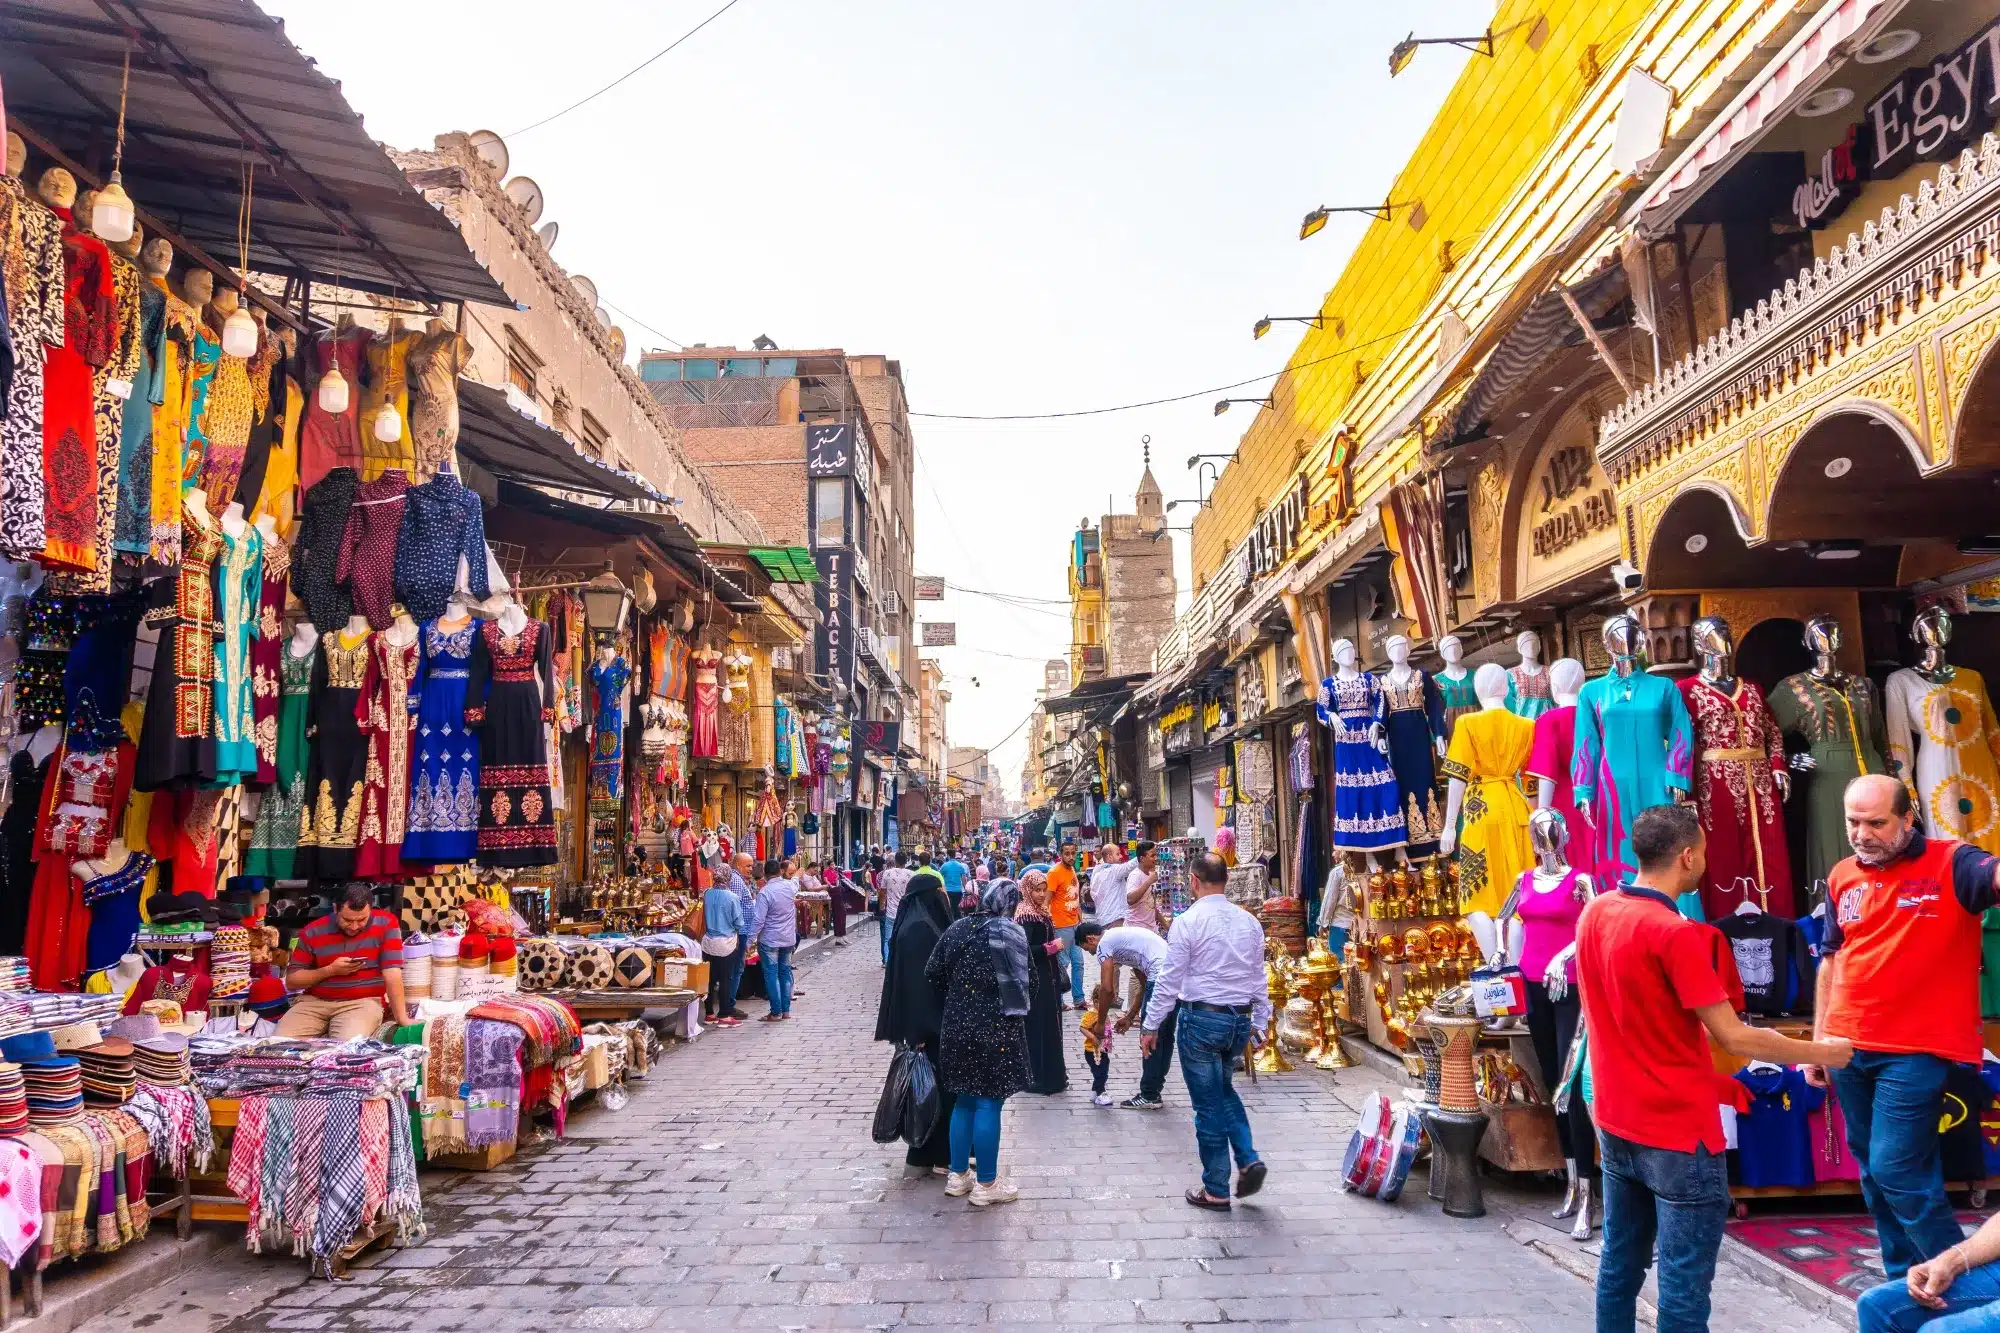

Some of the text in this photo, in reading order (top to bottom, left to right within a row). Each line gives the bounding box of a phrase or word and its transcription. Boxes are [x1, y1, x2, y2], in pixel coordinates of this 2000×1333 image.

[1792, 148, 1840, 228] Mall
[1252, 472, 1308, 573] Egypt
[1532, 504, 1585, 558] REDA
